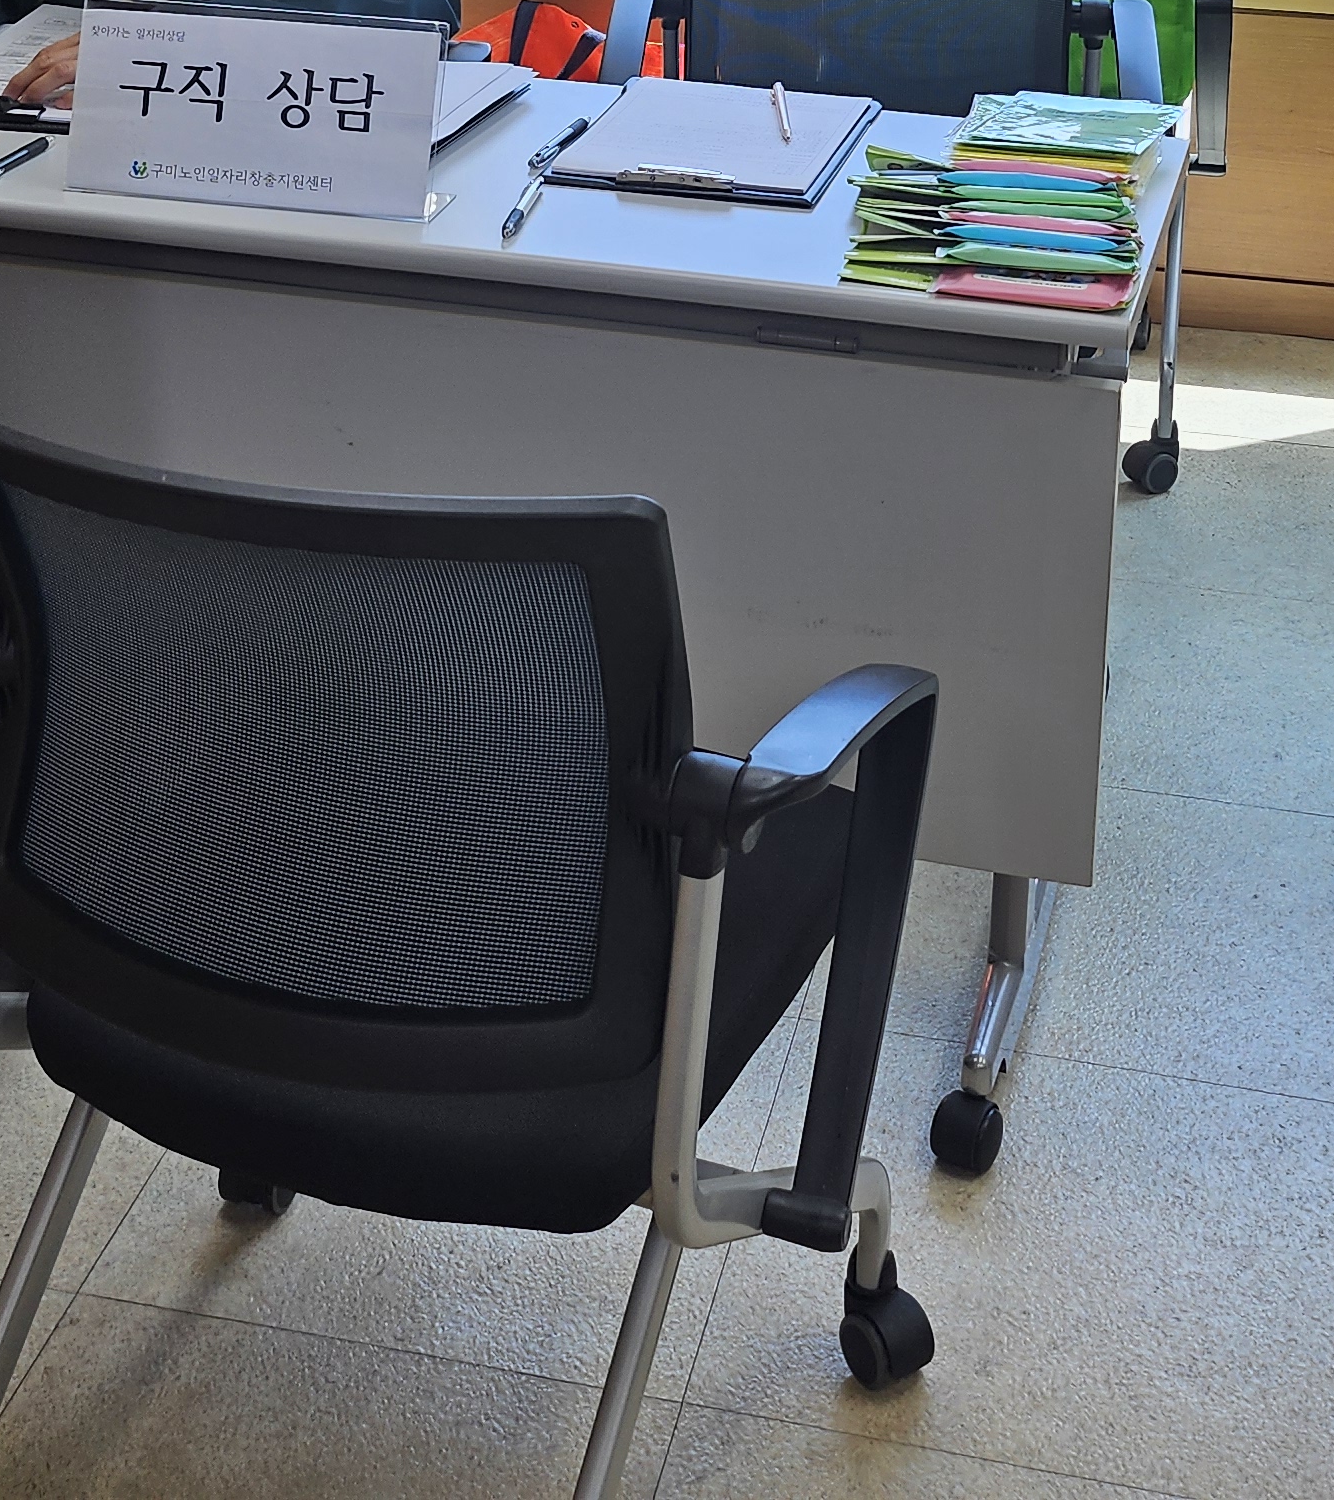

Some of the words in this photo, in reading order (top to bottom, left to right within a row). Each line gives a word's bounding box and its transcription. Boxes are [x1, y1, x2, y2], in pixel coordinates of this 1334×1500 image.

[92, 25, 130, 38] 찾아가는
[137, 28, 185, 42] 일자리상담
[118, 59, 228, 123] 구직
[266, 67, 385, 133] 상담
[151, 163, 333, 192] 구미노인일자리창출지원센터
